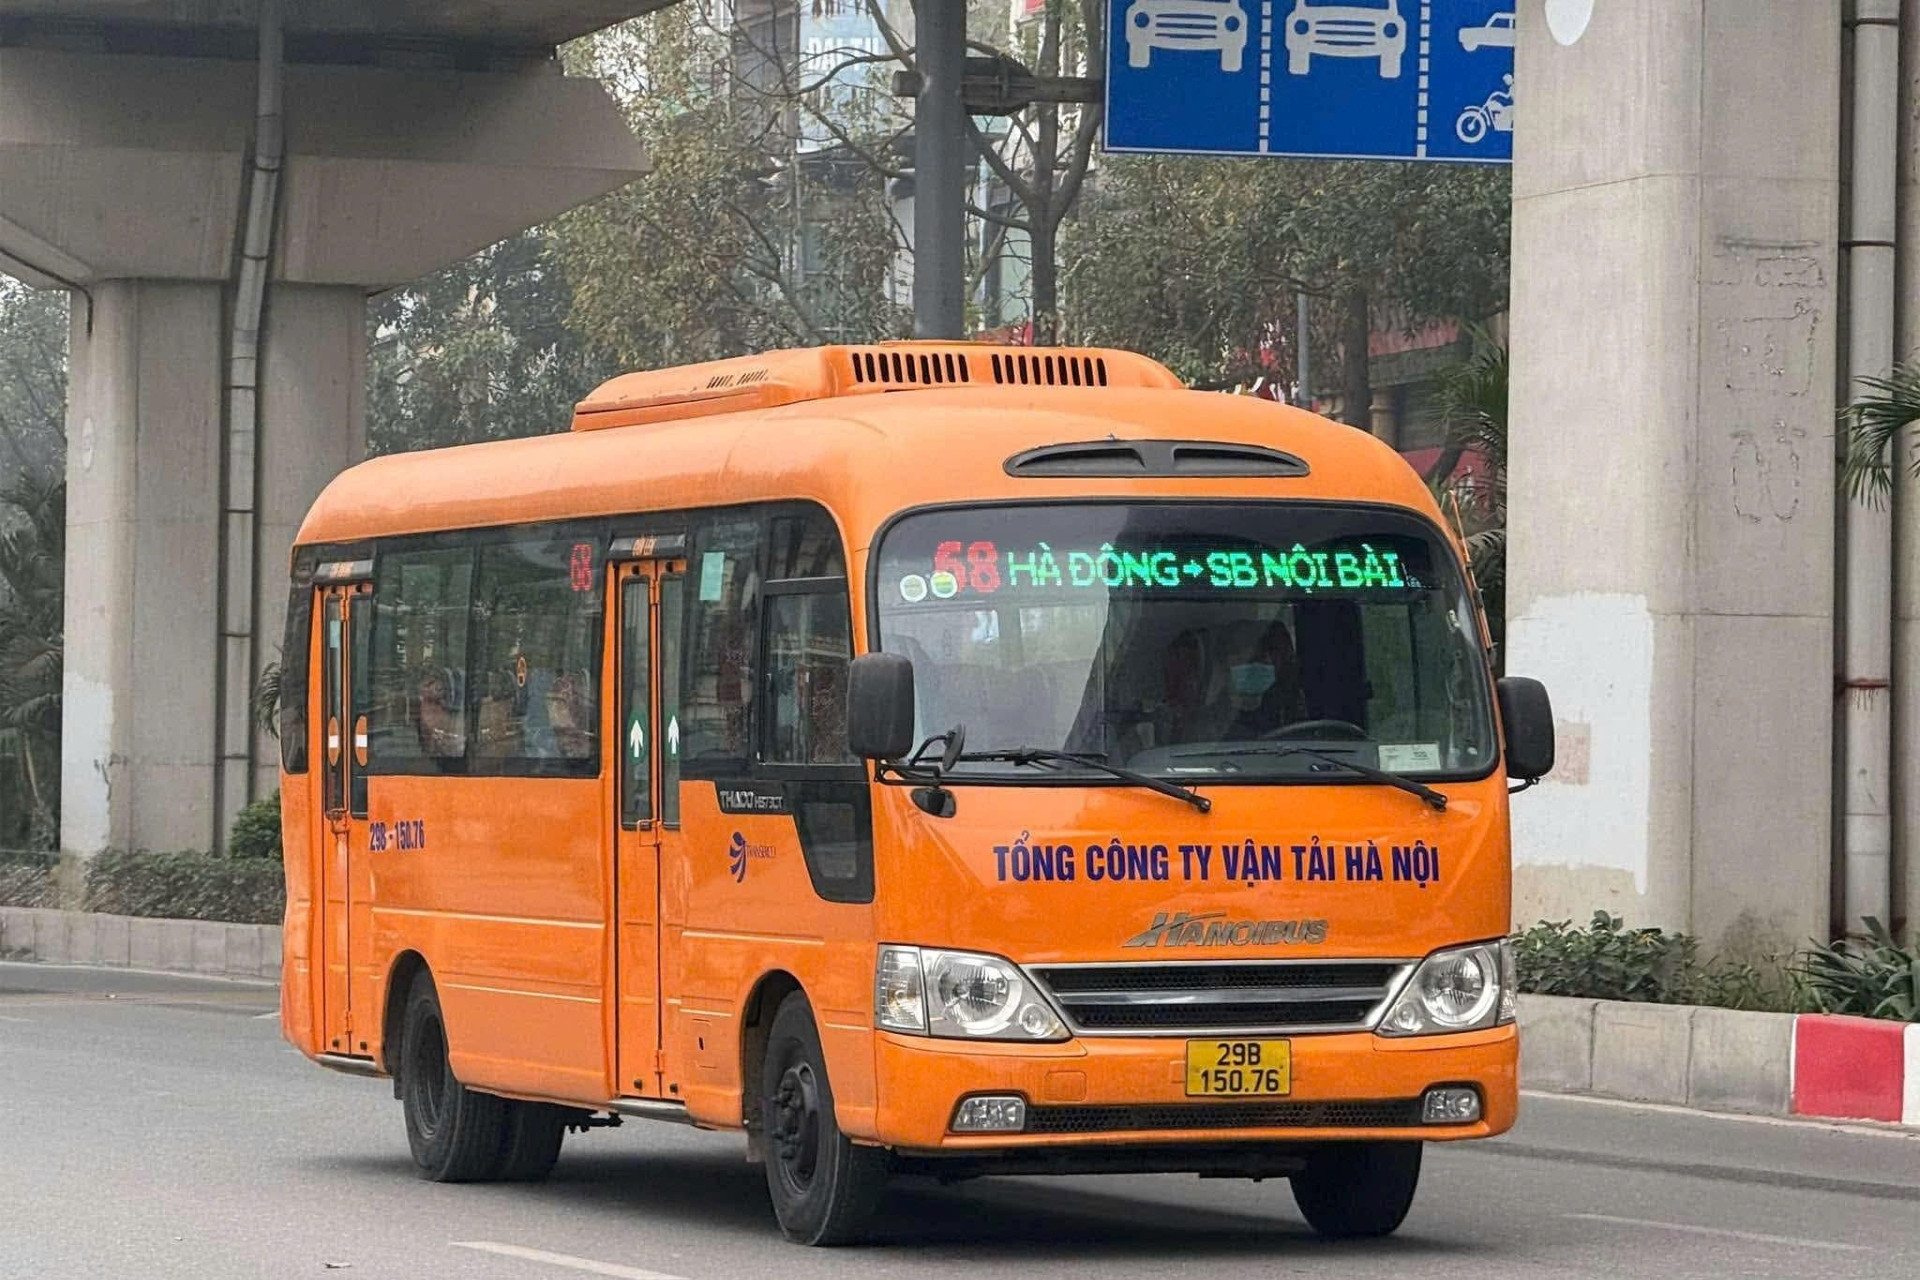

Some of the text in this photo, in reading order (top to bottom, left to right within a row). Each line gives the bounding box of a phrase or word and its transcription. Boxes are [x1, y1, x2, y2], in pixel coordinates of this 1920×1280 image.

[934, 541, 1000, 592] 68
[1007, 542, 1062, 586] HÀ
[1068, 542, 1180, 587] ĐÔNG
[1206, 552, 1258, 587] SB
[1262, 543, 1333, 593] NỘI
[1335, 543, 1404, 587] BÀI
[720, 790, 754, 809] THACO
[993, 830, 1440, 888] TỔNG CÔNG TY VẬN TẢI HÀ NỘI
[1121, 912, 1329, 948] HANOIBUS
[1217, 1043, 1261, 1066] 29B
[1201, 1069, 1279, 1092] 150.76
